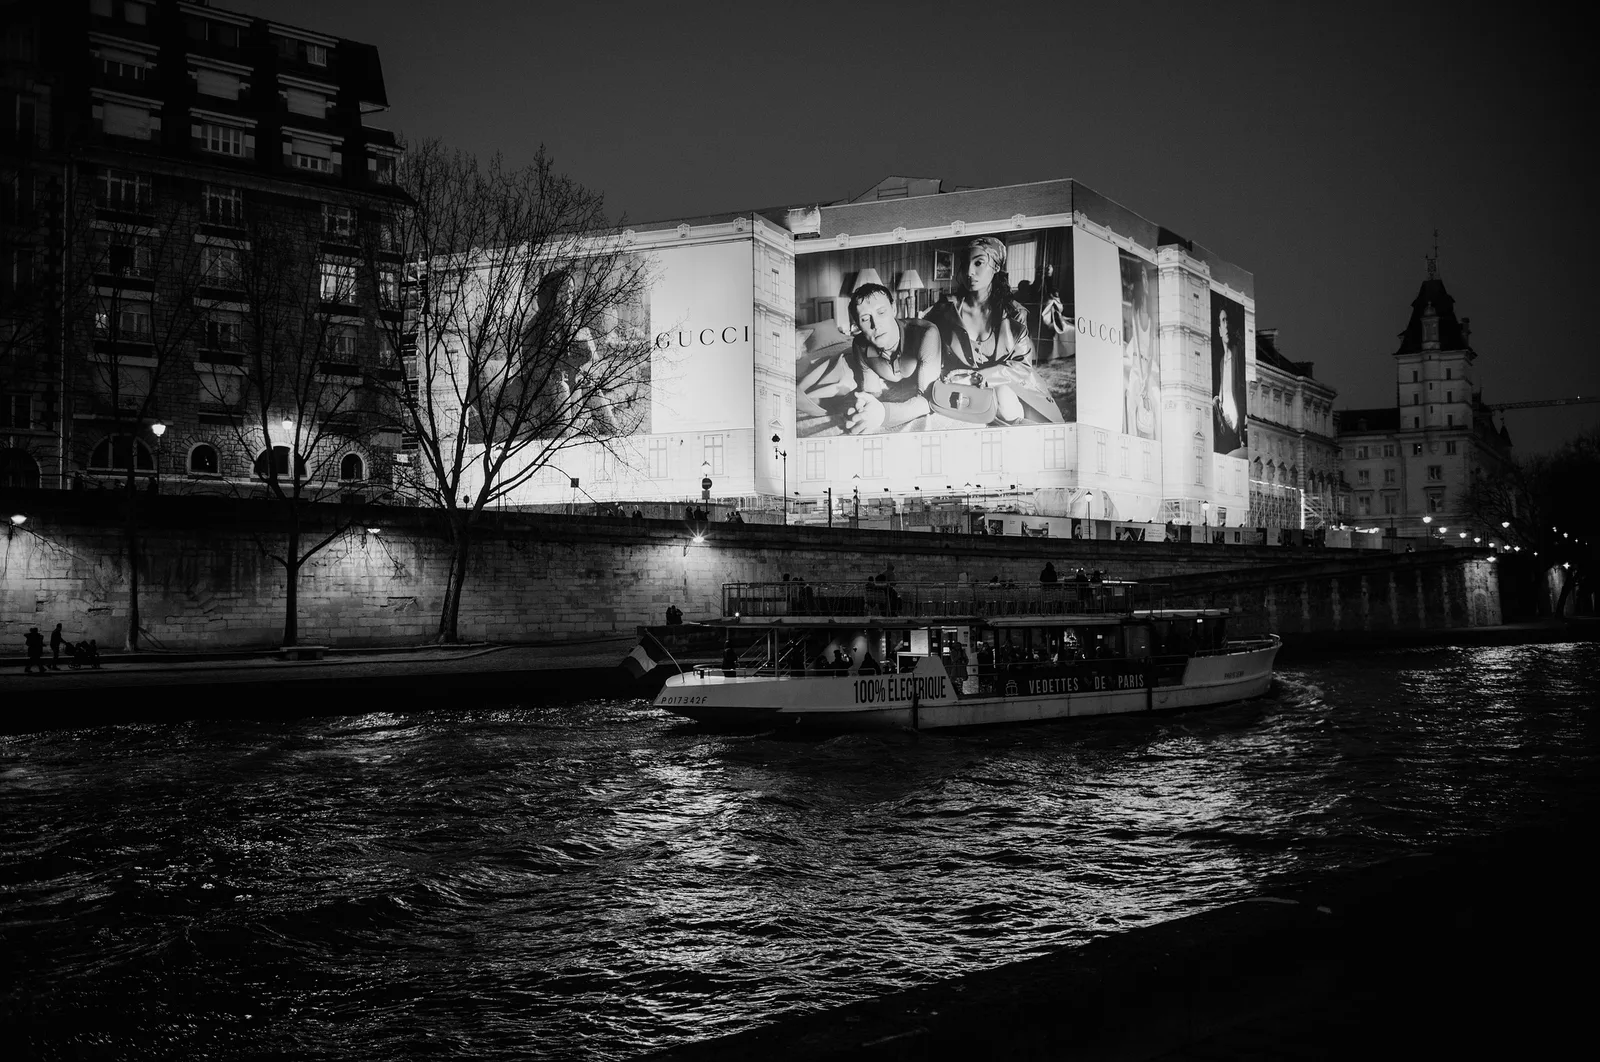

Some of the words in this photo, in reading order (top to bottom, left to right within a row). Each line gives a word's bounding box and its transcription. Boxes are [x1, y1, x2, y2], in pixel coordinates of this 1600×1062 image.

[656, 325, 748, 349] GUCCI
[1077, 316, 1121, 346] GUCCI
[853, 679, 886, 703] 100%
[888, 675, 947, 702] ÉLECTRIQUE
[1028, 677, 1080, 694] VEDETTES
[1094, 675, 1107, 690] DE
[1118, 673, 1145, 689] PARIS
